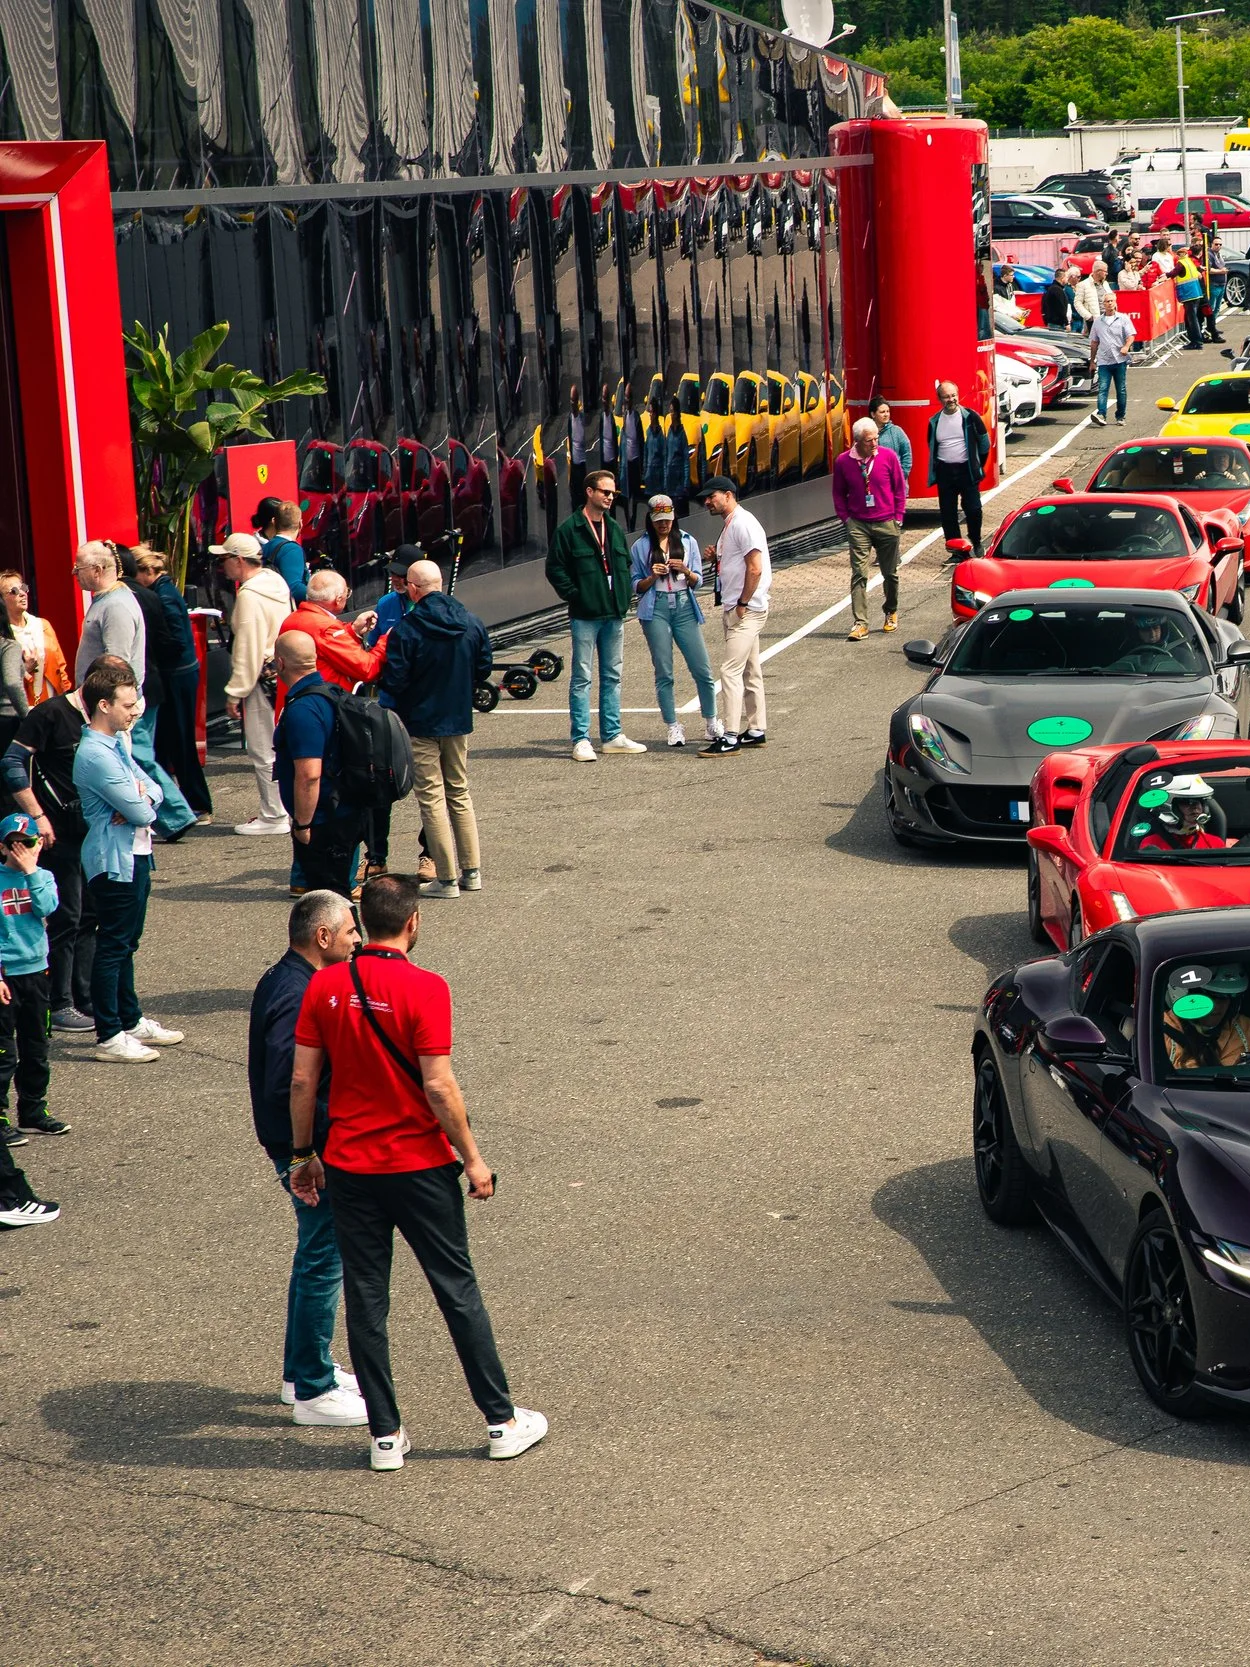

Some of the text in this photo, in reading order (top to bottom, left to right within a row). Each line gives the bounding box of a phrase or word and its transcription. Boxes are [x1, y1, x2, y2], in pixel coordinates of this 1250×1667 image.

[987, 613, 1000, 622] 1
[1150, 775, 1166, 786] 1
[1180, 970, 1202, 984] 1
